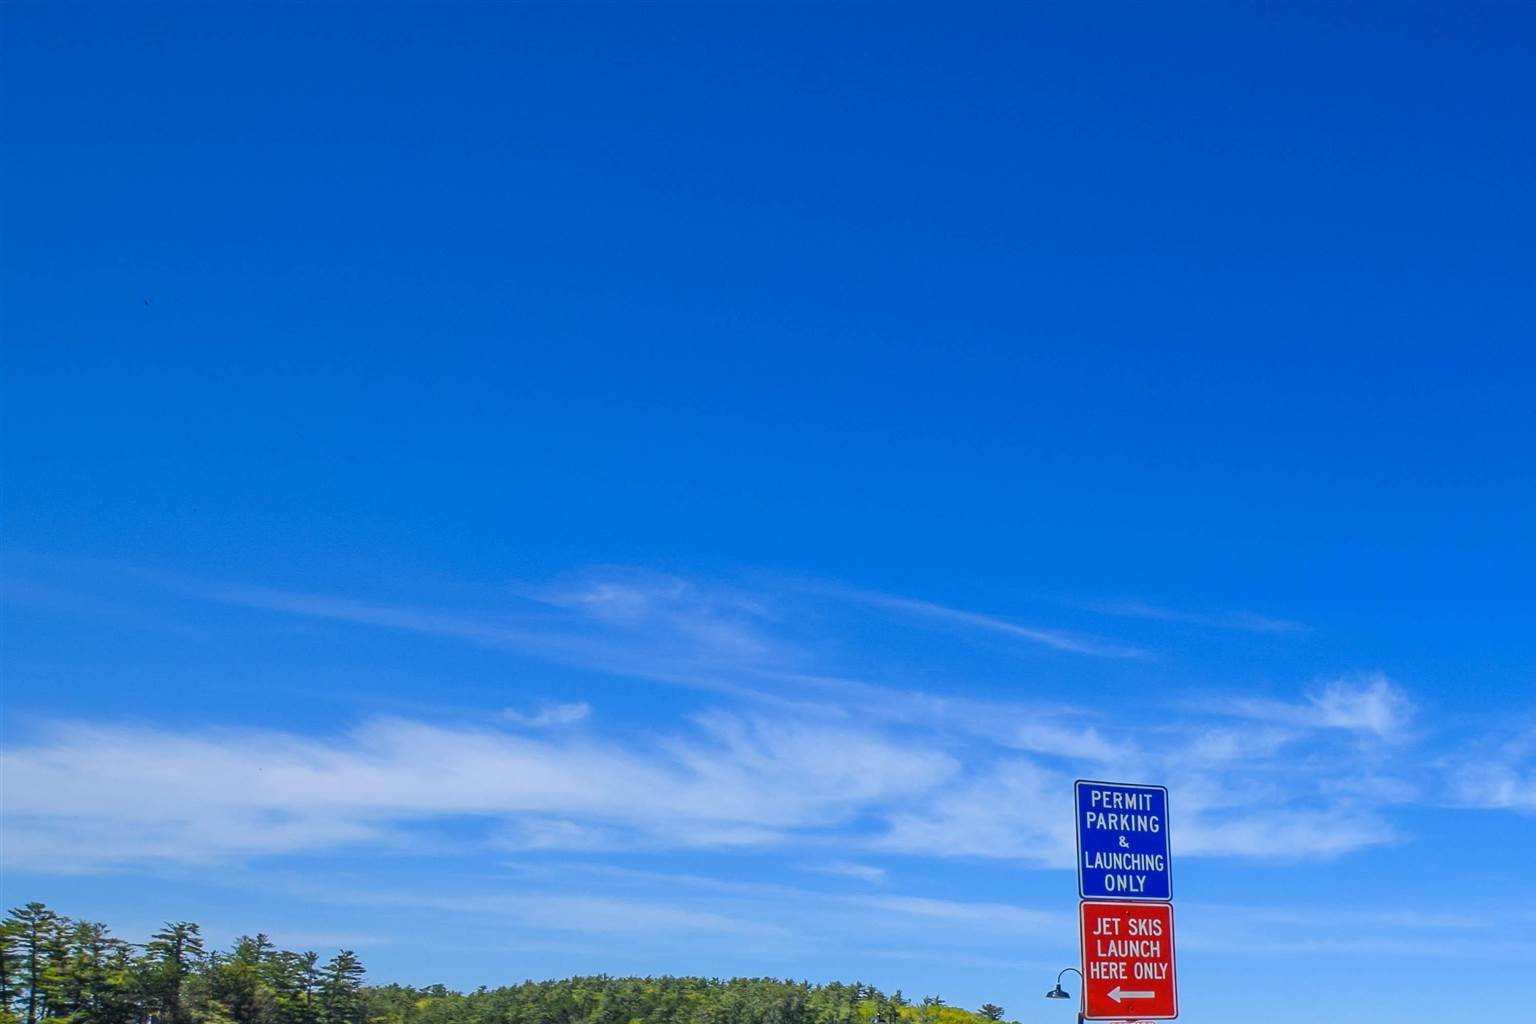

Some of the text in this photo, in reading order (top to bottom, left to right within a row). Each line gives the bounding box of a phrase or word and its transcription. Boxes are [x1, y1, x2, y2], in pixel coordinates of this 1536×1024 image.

[1091, 790, 1152, 811] PERMIT
[1086, 811, 1160, 833] PARKING
[1119, 835, 1130, 848] &
[1085, 851, 1164, 872] LAUNCHING
[1104, 874, 1147, 892] ONLY
[1093, 917, 1162, 936] JET SKIS
[1097, 939, 1161, 958] LAUNCH
[1090, 961, 1168, 979] HERE ONLY
